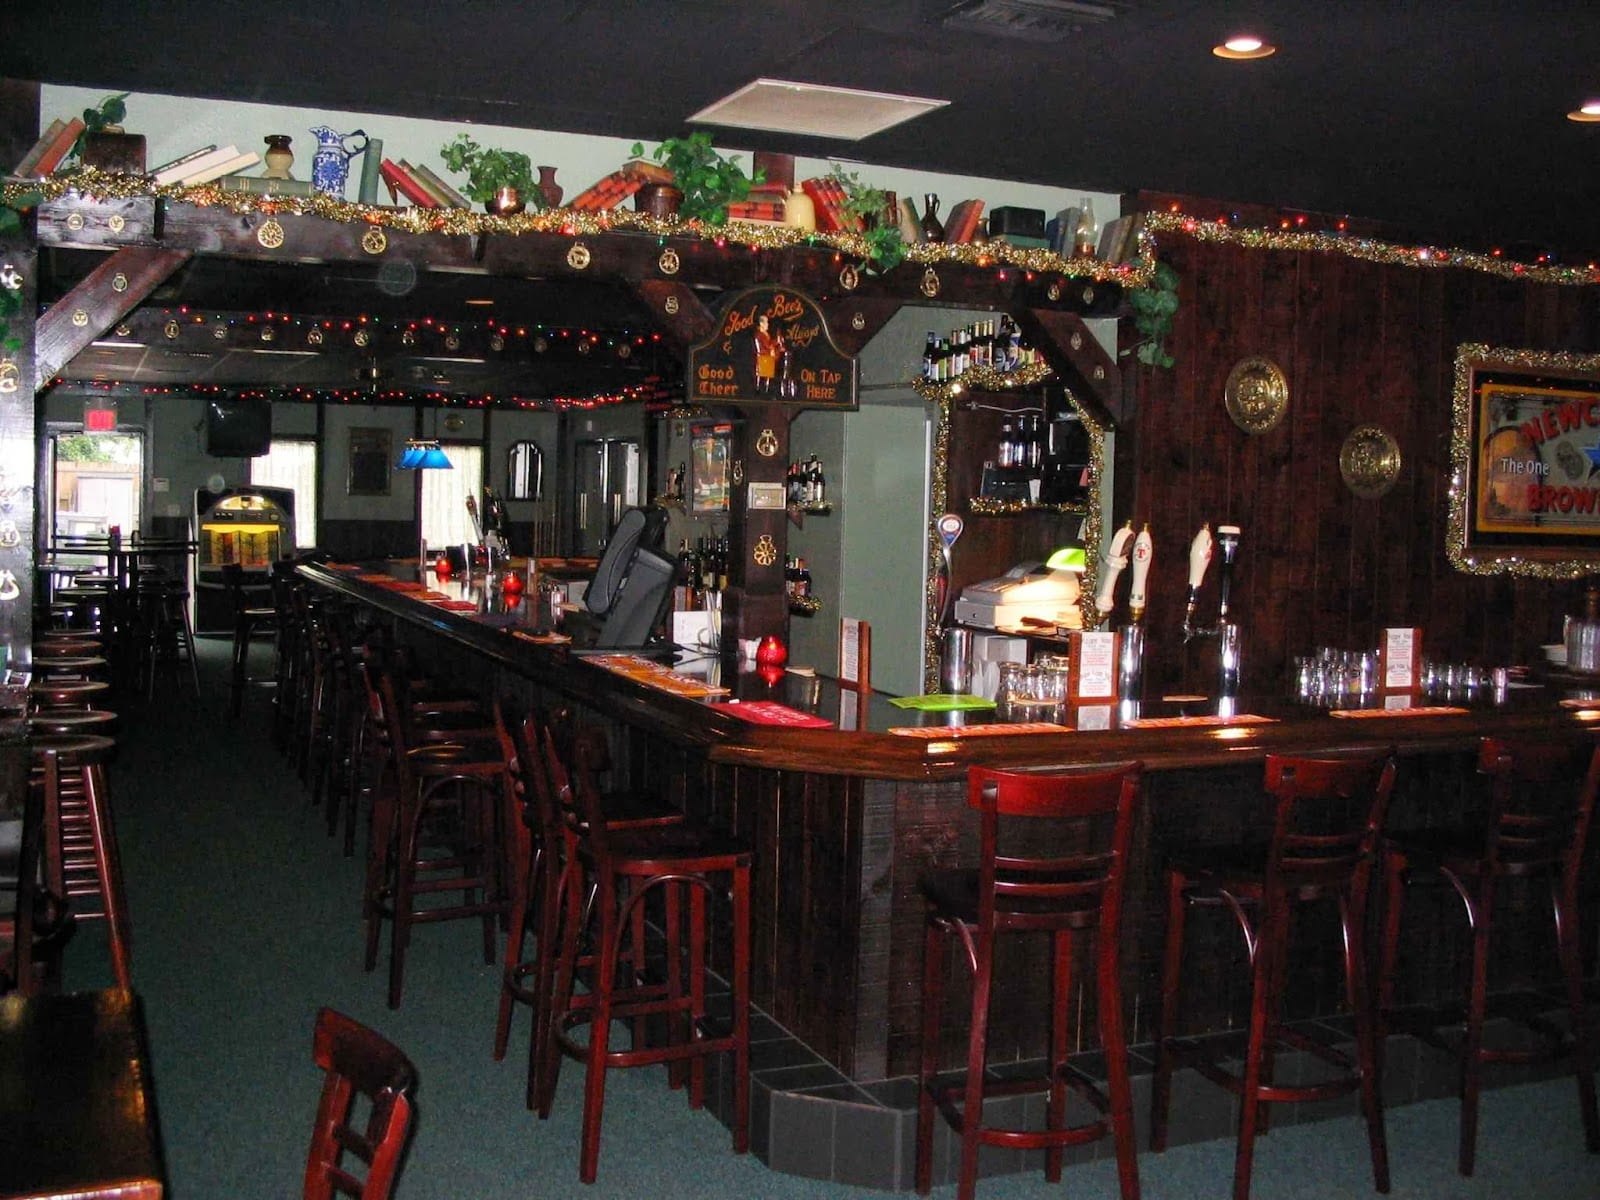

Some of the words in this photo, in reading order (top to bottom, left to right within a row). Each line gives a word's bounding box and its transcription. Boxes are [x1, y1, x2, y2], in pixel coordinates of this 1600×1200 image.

[698, 364, 734, 380] Good
[820, 369, 842, 384] TAP
[699, 381, 739, 395] Cheer
[806, 385, 836, 399] HERE
[1501, 457, 1525, 476] The
[1526, 459, 1549, 476] One
[1525, 484, 1600, 515] BROW
